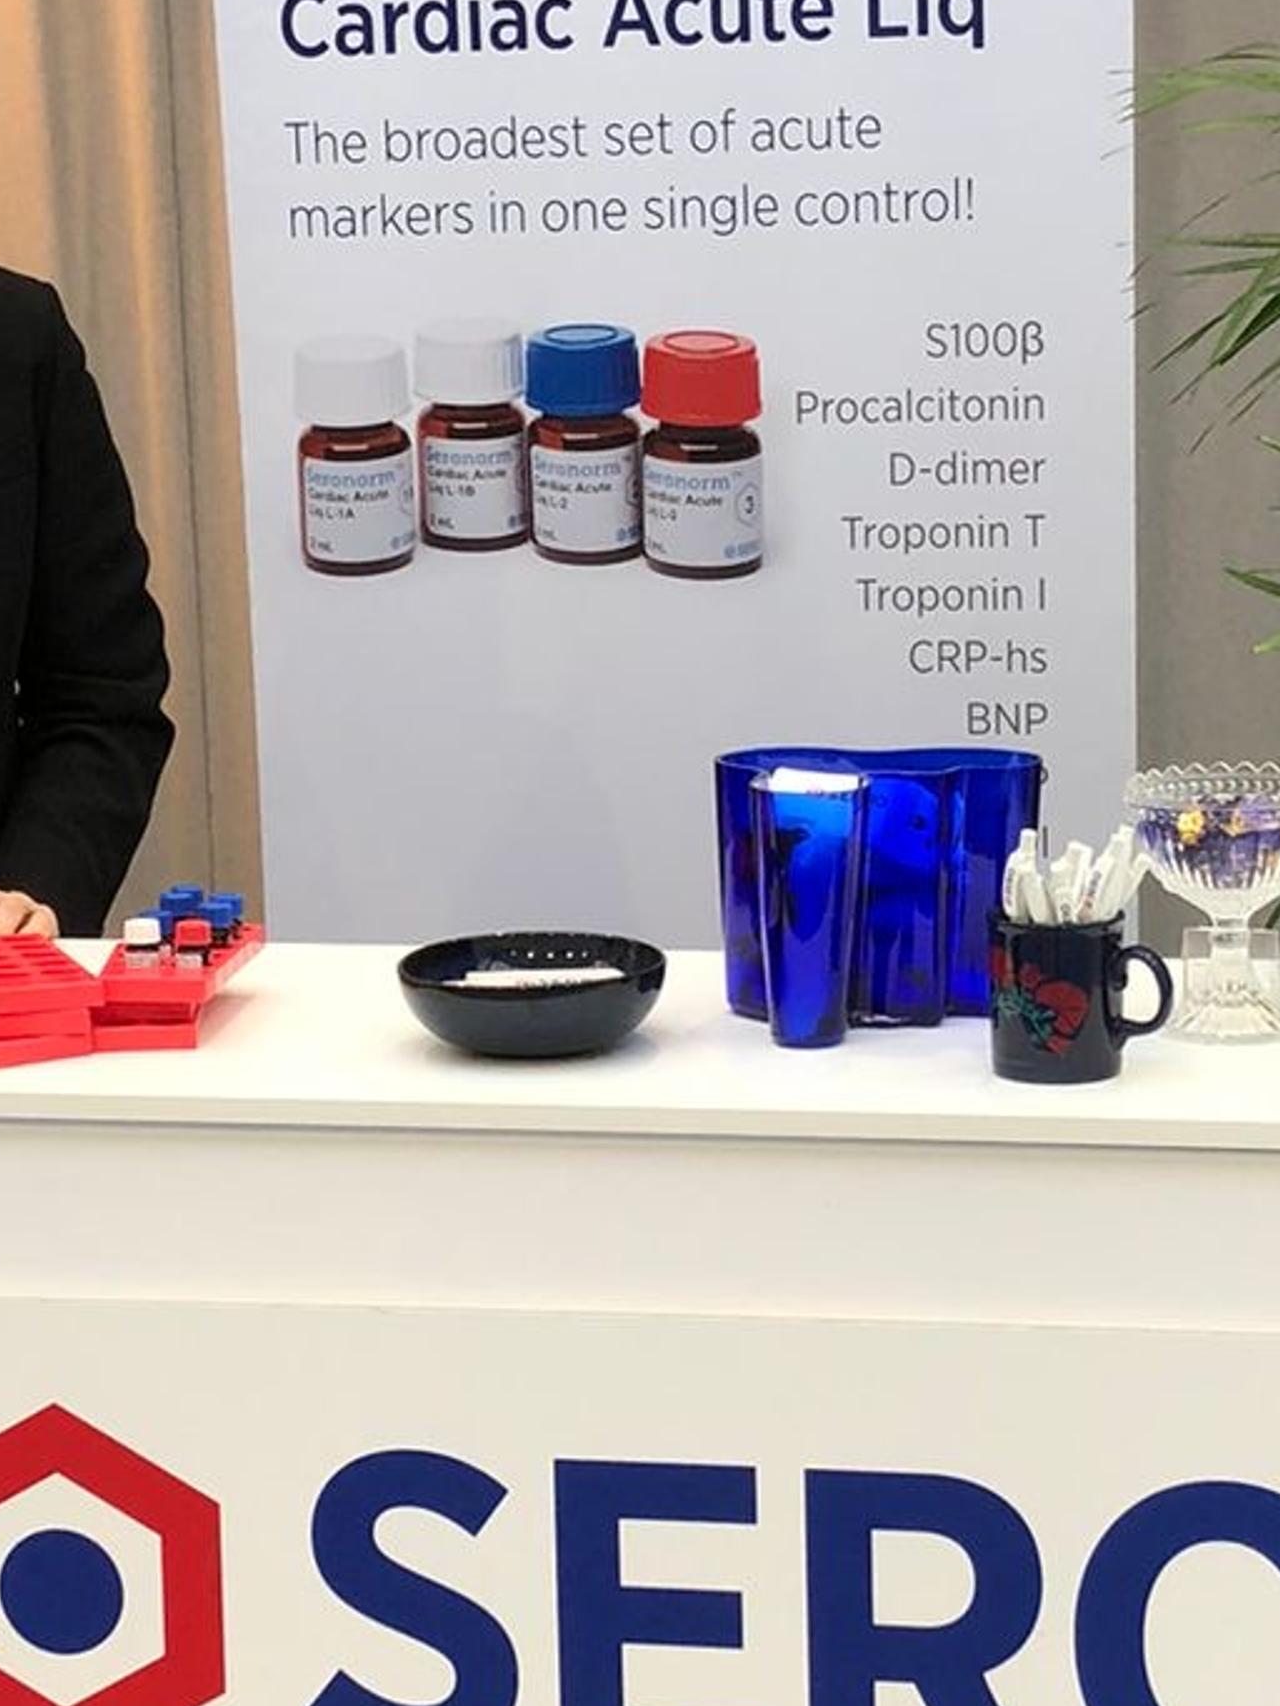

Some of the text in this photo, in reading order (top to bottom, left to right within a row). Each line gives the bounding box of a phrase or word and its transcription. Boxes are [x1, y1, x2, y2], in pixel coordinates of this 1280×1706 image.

[283, 106, 882, 165] The broadest set of acute
[289, 175, 974, 239] markers in one single control!
[796, 386, 1045, 425] Procalcitonin
[889, 450, 1046, 487] D-dimer
[841, 513, 1047, 555] Troponin T
[855, 576, 1023, 618] Troponin
[908, 638, 1048, 675] CRP-hs
[966, 700, 1049, 736] BNP
